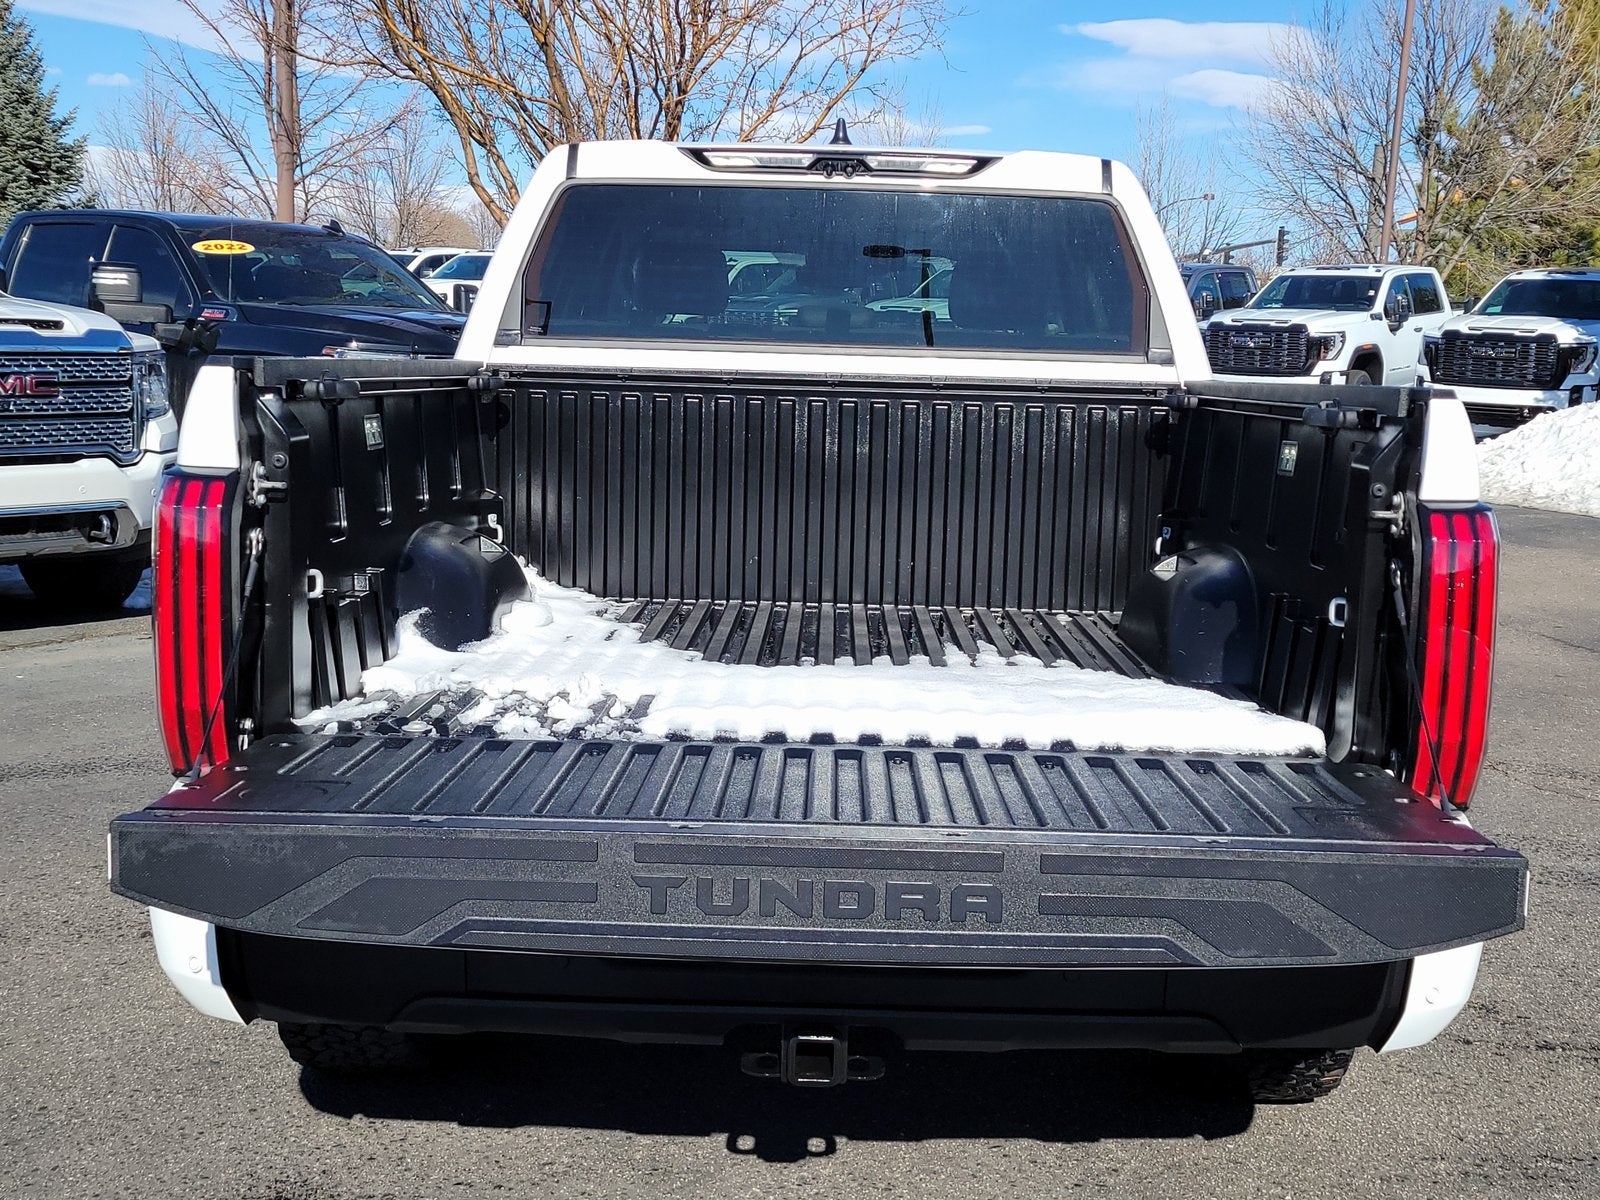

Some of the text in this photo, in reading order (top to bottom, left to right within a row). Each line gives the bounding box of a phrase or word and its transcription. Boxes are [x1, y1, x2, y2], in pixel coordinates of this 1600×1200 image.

[202, 243, 247, 251] 2022
[0, 374, 59, 395] MC
[631, 874, 1003, 923] TUNDRA
